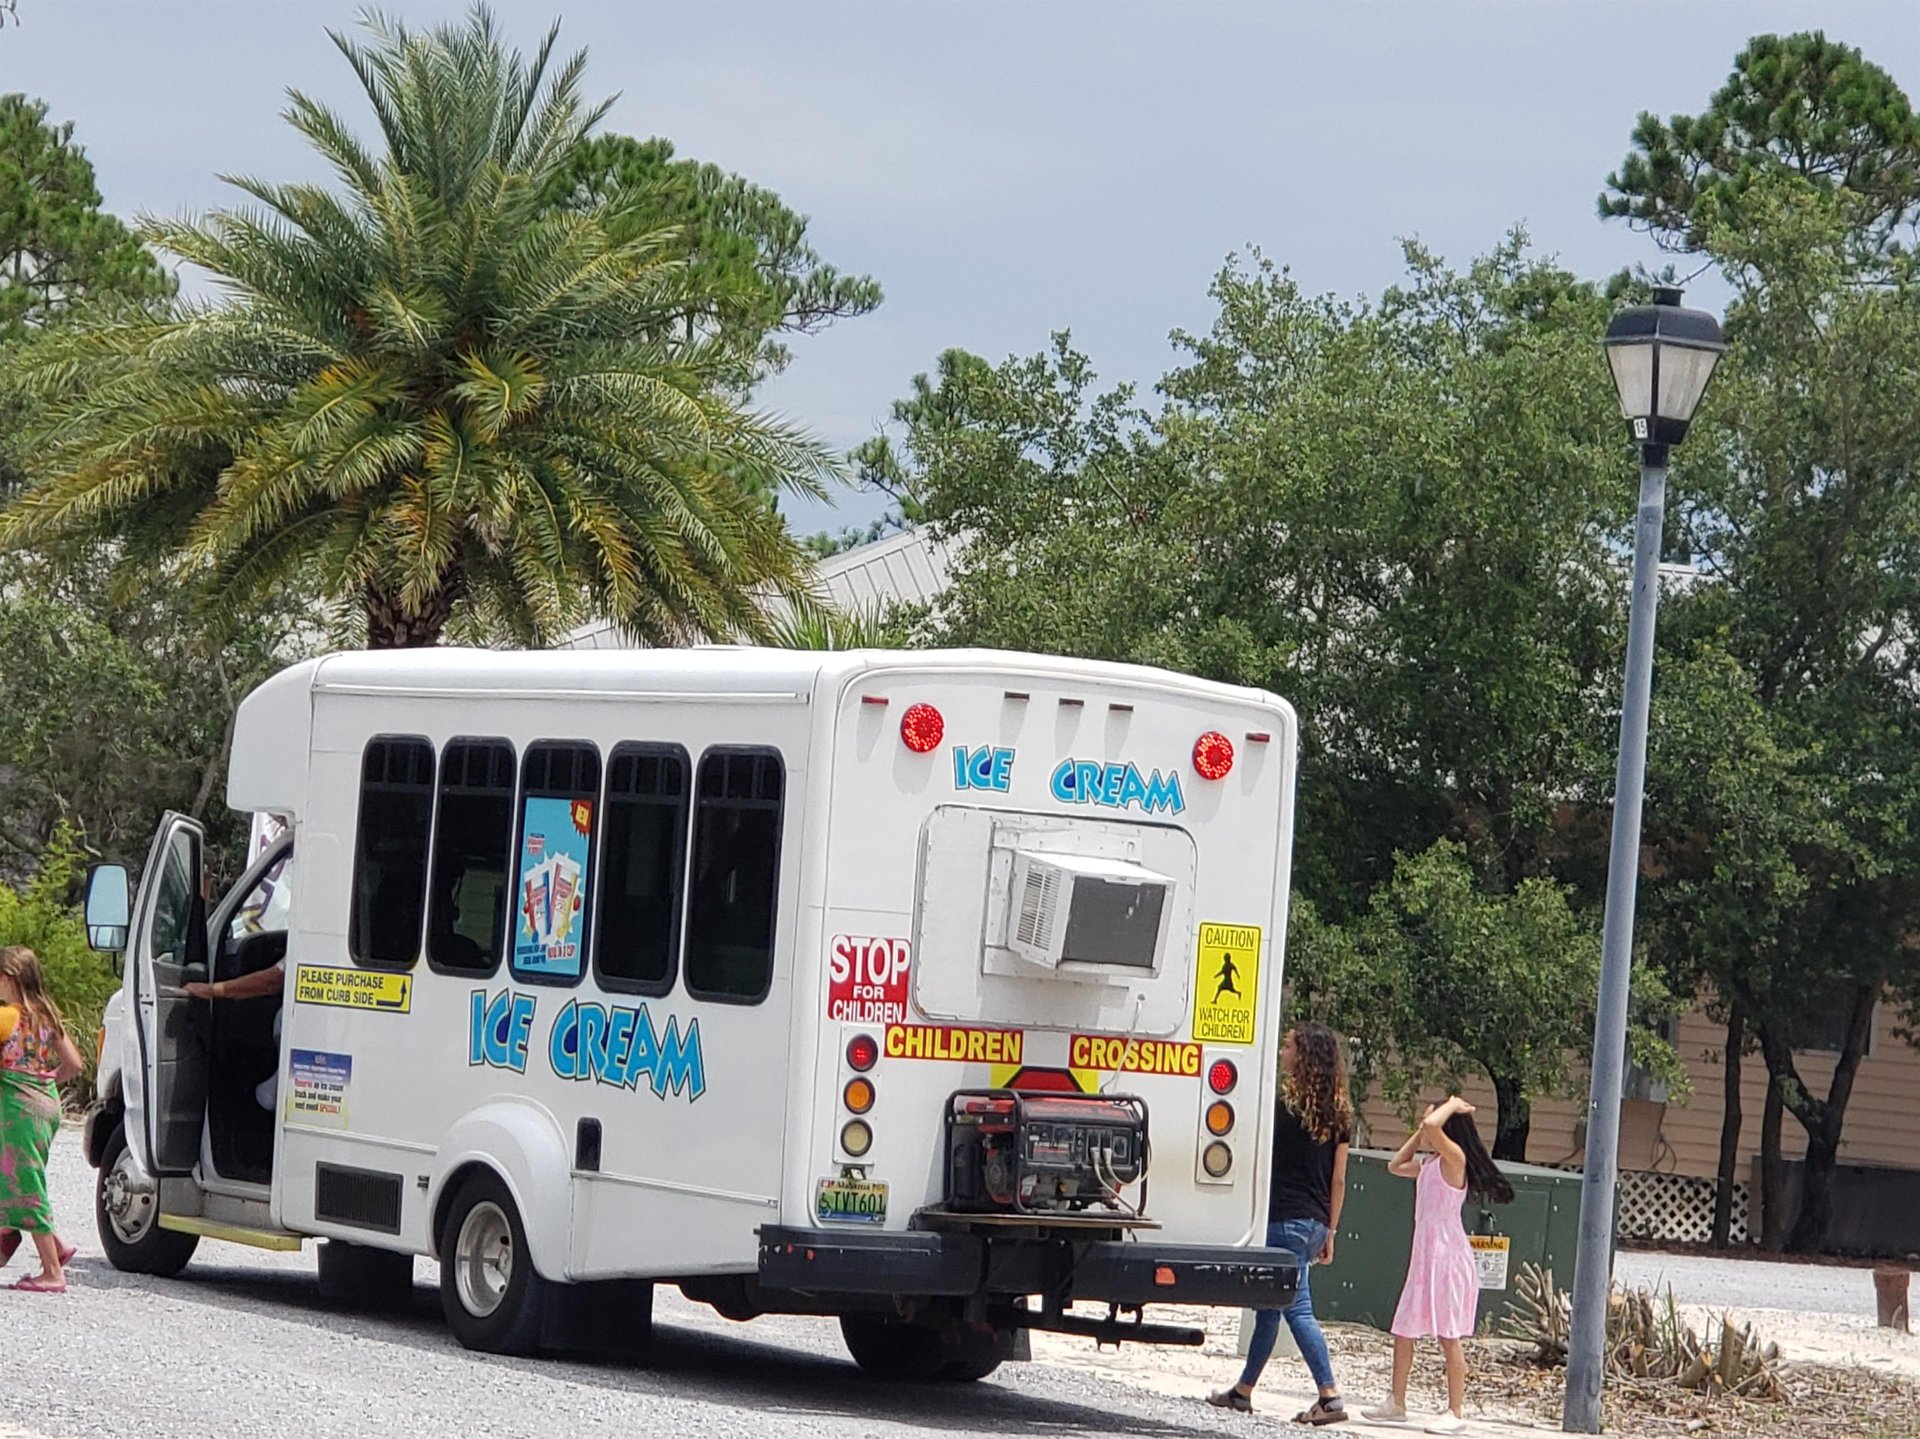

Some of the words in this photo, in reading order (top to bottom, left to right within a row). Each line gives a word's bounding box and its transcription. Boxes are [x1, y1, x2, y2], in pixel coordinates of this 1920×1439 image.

[1635, 420, 1646, 434] 15
[952, 744, 1016, 793] ICE
[1050, 758, 1186, 816] CREAM
[1206, 927, 1254, 948] CAUTION
[830, 934, 911, 986] STOP
[301, 970, 333, 984] PLEASE
[336, 974, 384, 989] PURCHASE
[300, 986, 324, 1000] FROM
[326, 989, 351, 1003] CURB
[353, 991, 374, 1005] SIDE
[853, 985, 884, 1000] FOR
[832, 999, 903, 1024] CHILDREN
[1200, 1007, 1230, 1022] WATCH
[1231, 1009, 1250, 1024] FOR
[1201, 1022, 1246, 1039] CHILDREN
[469, 987, 537, 1075] ICE
[548, 996, 706, 1103] CREAM
[886, 1025, 1022, 1062] CHILDREN
[1072, 1037, 1199, 1075] CROSSING
